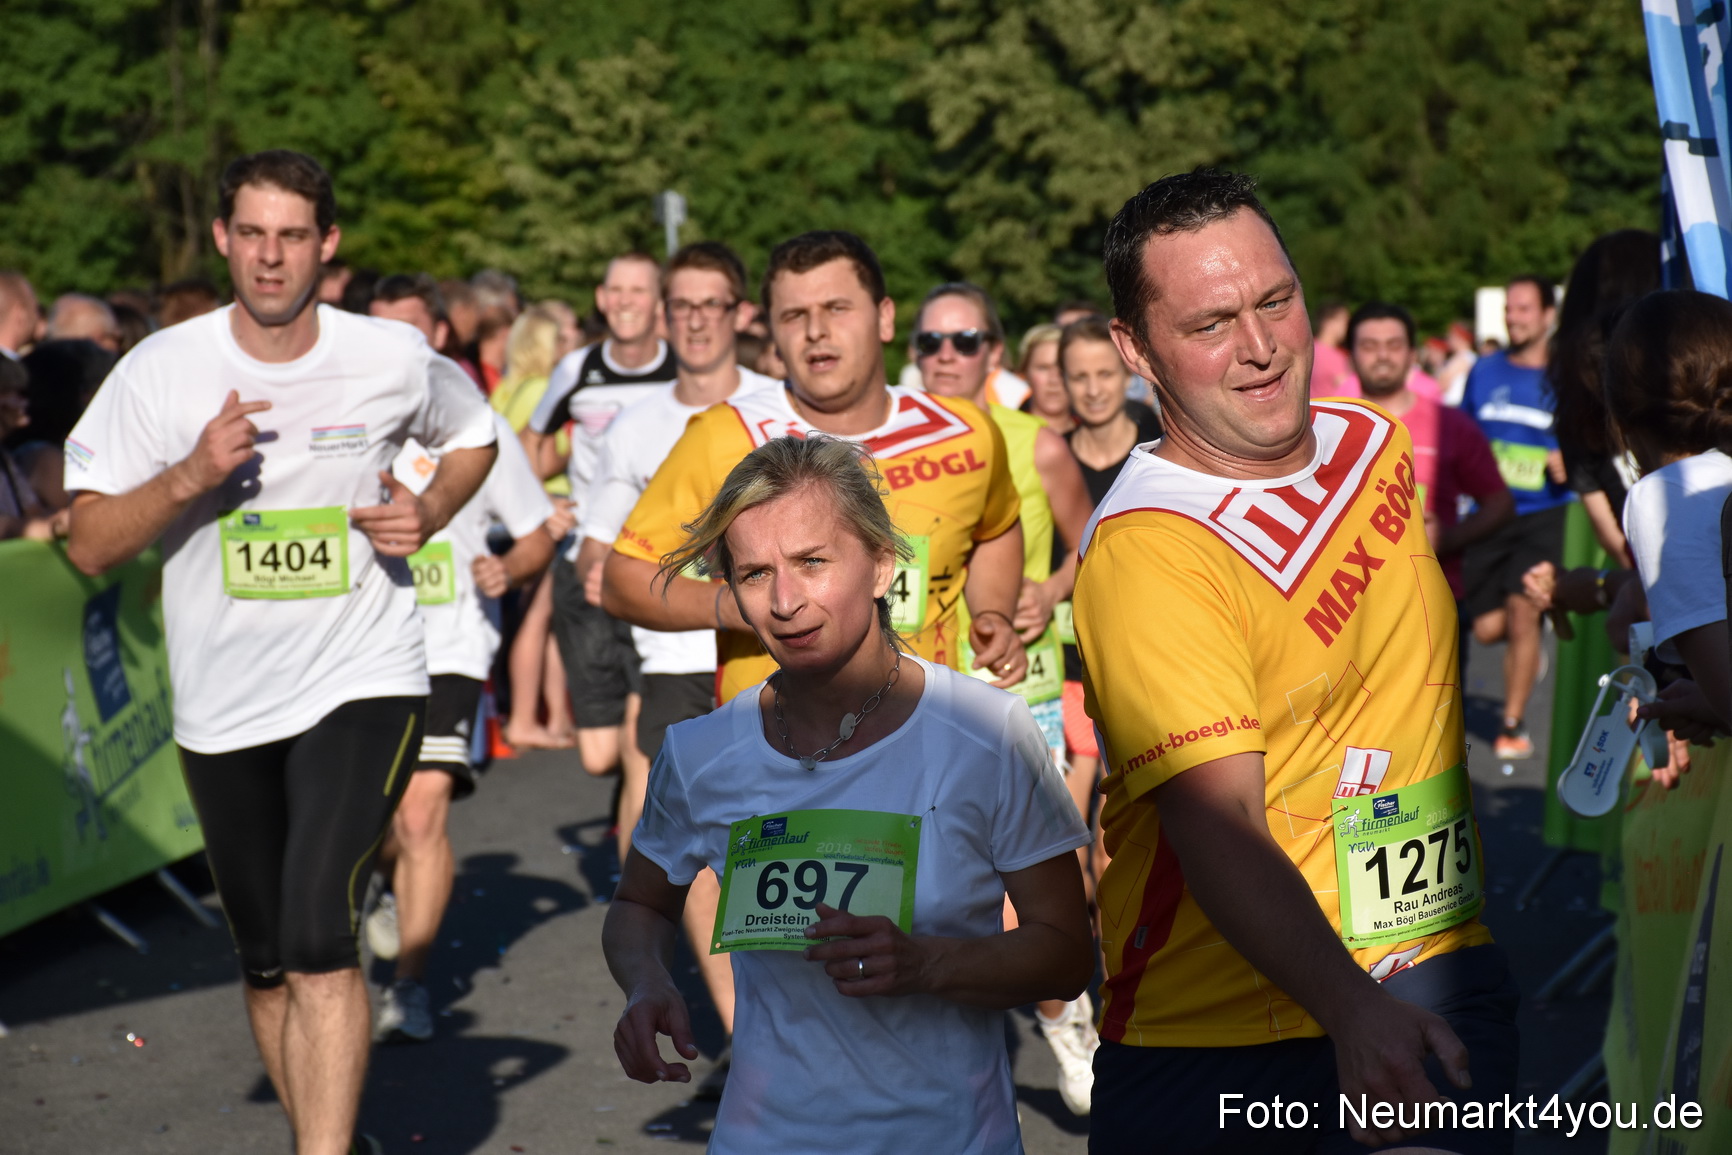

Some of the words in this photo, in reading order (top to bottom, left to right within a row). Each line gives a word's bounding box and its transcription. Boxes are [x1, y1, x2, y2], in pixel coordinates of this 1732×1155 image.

[884, 448, 986, 491] BÖGL
[236, 538, 332, 573] 1404
[1304, 535, 1386, 648] MAX
[1597, 729, 1609, 748] SDK
[1362, 805, 1420, 832] firmenlauf
[1427, 808, 1448, 827] 2018
[749, 831, 810, 850] firmenlauf
[1362, 827, 1391, 836] neumarkt
[816, 842, 853, 854] 2018
[1365, 818, 1471, 900] 1275
[757, 860, 869, 913] 697
[1394, 900, 1419, 914] Rau
[1422, 882, 1464, 907] Andreas
[745, 913, 810, 927] Dreistein
[1374, 920, 1393, 930] Max
[1396, 913, 1416, 925] Bögl
[1418, 901, 1457, 920] Bauservice
[1459, 890, 1475, 905] GmbH
[722, 929, 745, 937] Fuel-Tec
